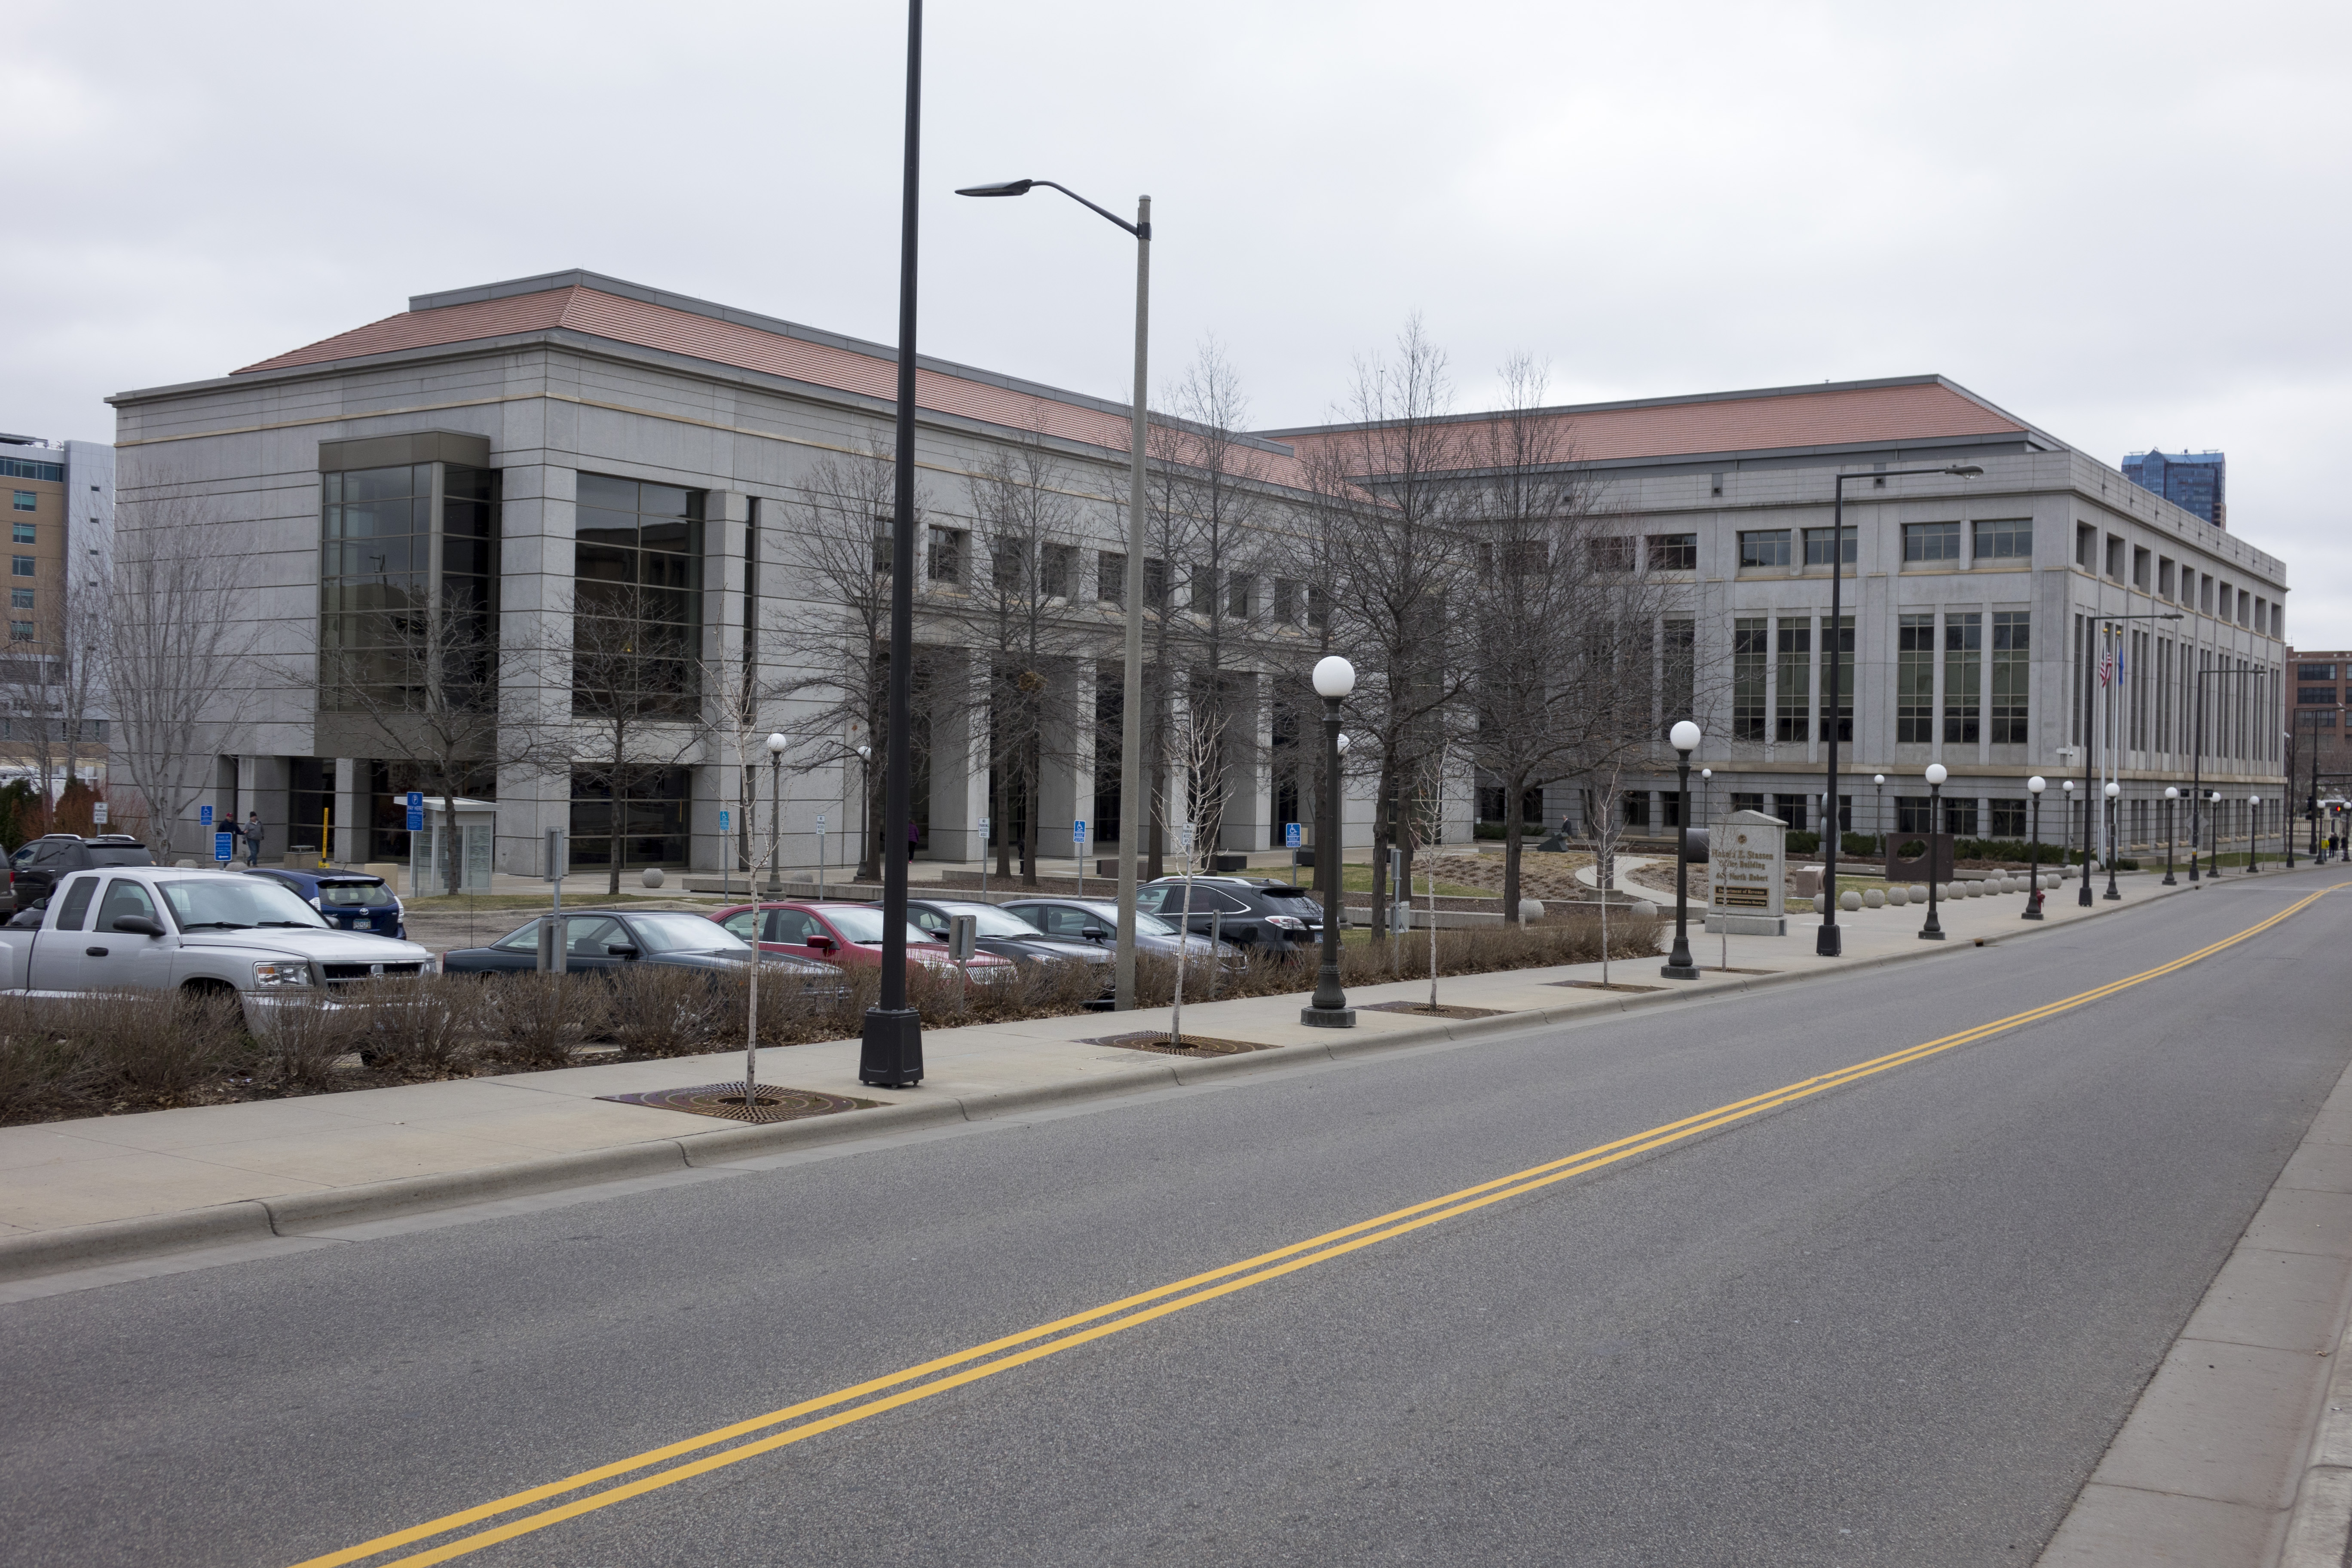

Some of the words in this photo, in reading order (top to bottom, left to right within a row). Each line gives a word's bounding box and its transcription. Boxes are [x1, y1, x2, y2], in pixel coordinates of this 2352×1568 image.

[1738, 850, 1745, 858] E.
[1747, 851, 1773, 860] Stassen
[1740, 861, 1765, 870] Building
[1730, 873, 1746, 881] North
